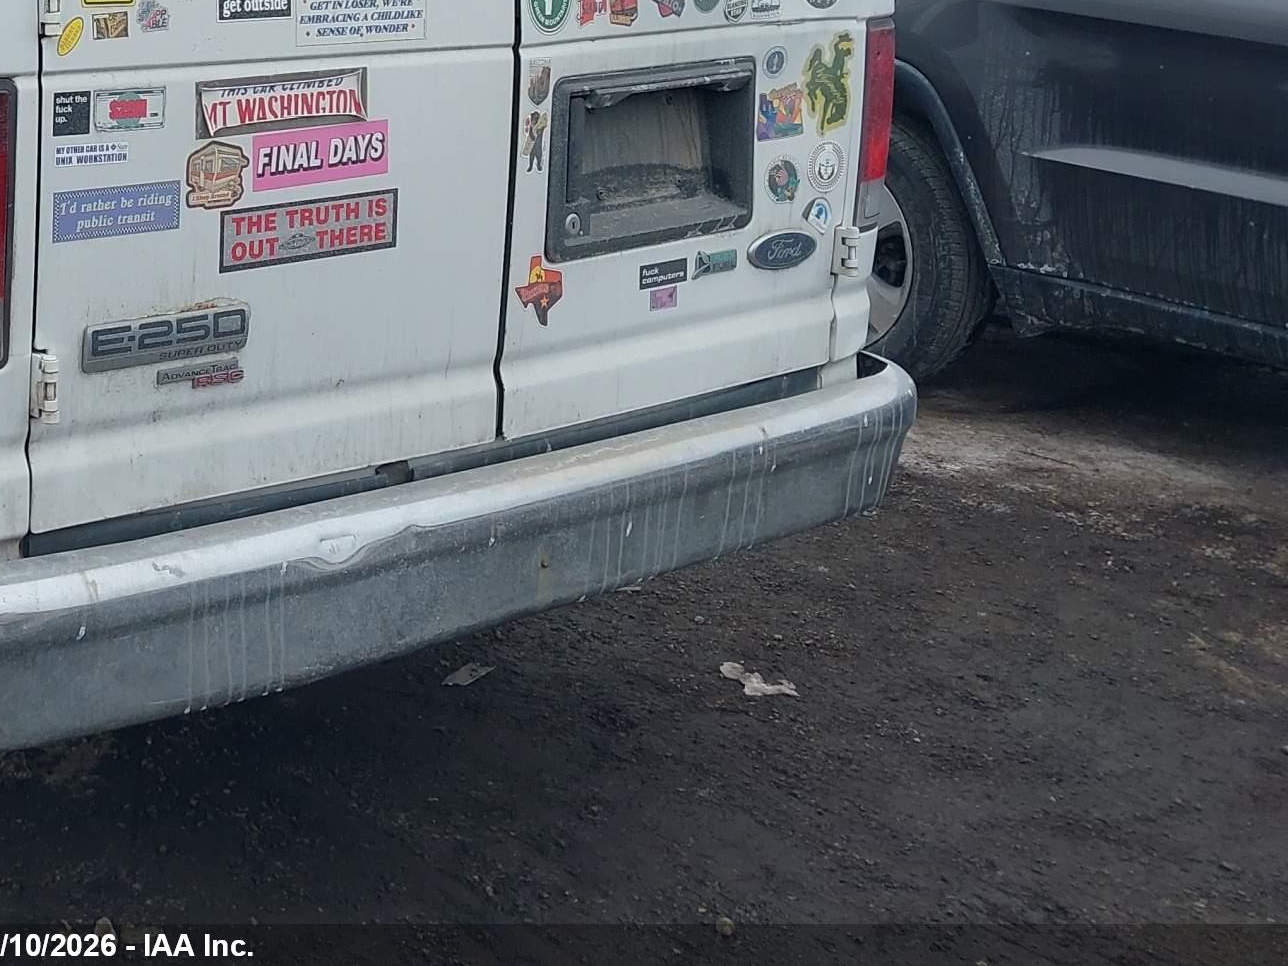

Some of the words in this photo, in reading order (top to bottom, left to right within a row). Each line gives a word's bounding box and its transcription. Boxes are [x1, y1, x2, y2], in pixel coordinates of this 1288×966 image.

[309, 1, 331, 10] GET
[332, 1, 344, 10] IN
[299, 13, 360, 25] EMBRACING
[362, 13, 368, 21] A
[370, 10, 423, 21] CHILDLIKE
[316, 26, 348, 37] SENSE
[349, 26, 362, 35] OF
[365, 24, 409, 34] WONDER
[55, 96, 73, 104] shut
[75, 95, 88, 103] the
[236, 89, 362, 124] WASHINGTON
[55, 105, 72, 113] fuck
[55, 115, 67, 124] up.
[56, 146, 65, 155] MY
[66, 145, 84, 154] OTHER
[85, 144, 98, 153] CAR
[99, 144, 105, 152] IS
[256, 141, 323, 178] FINAL
[328, 132, 385, 168] DAYS
[56, 155, 73, 166] UNIX
[76, 153, 127, 164] WORKSTATION
[60, 201, 77, 216] I'd
[80, 199, 117, 213] rather
[120, 197, 134, 208] be
[137, 194, 173, 207] riding
[76, 216, 114, 232] public
[117, 210, 155, 225] transit
[232, 213, 277, 235] THE
[285, 201, 359, 228] TRUTH
[368, 198, 388, 217] IS
[231, 237, 279, 262] OUT
[316, 222, 387, 249] THERE
[767, 238, 802, 260] Ford
[642, 267, 659, 277] fuck
[642, 270, 685, 285] computers
[159, 347, 203, 360] SUPER
[207, 340, 243, 352] DUTY
[193, 369, 245, 389] RSC
